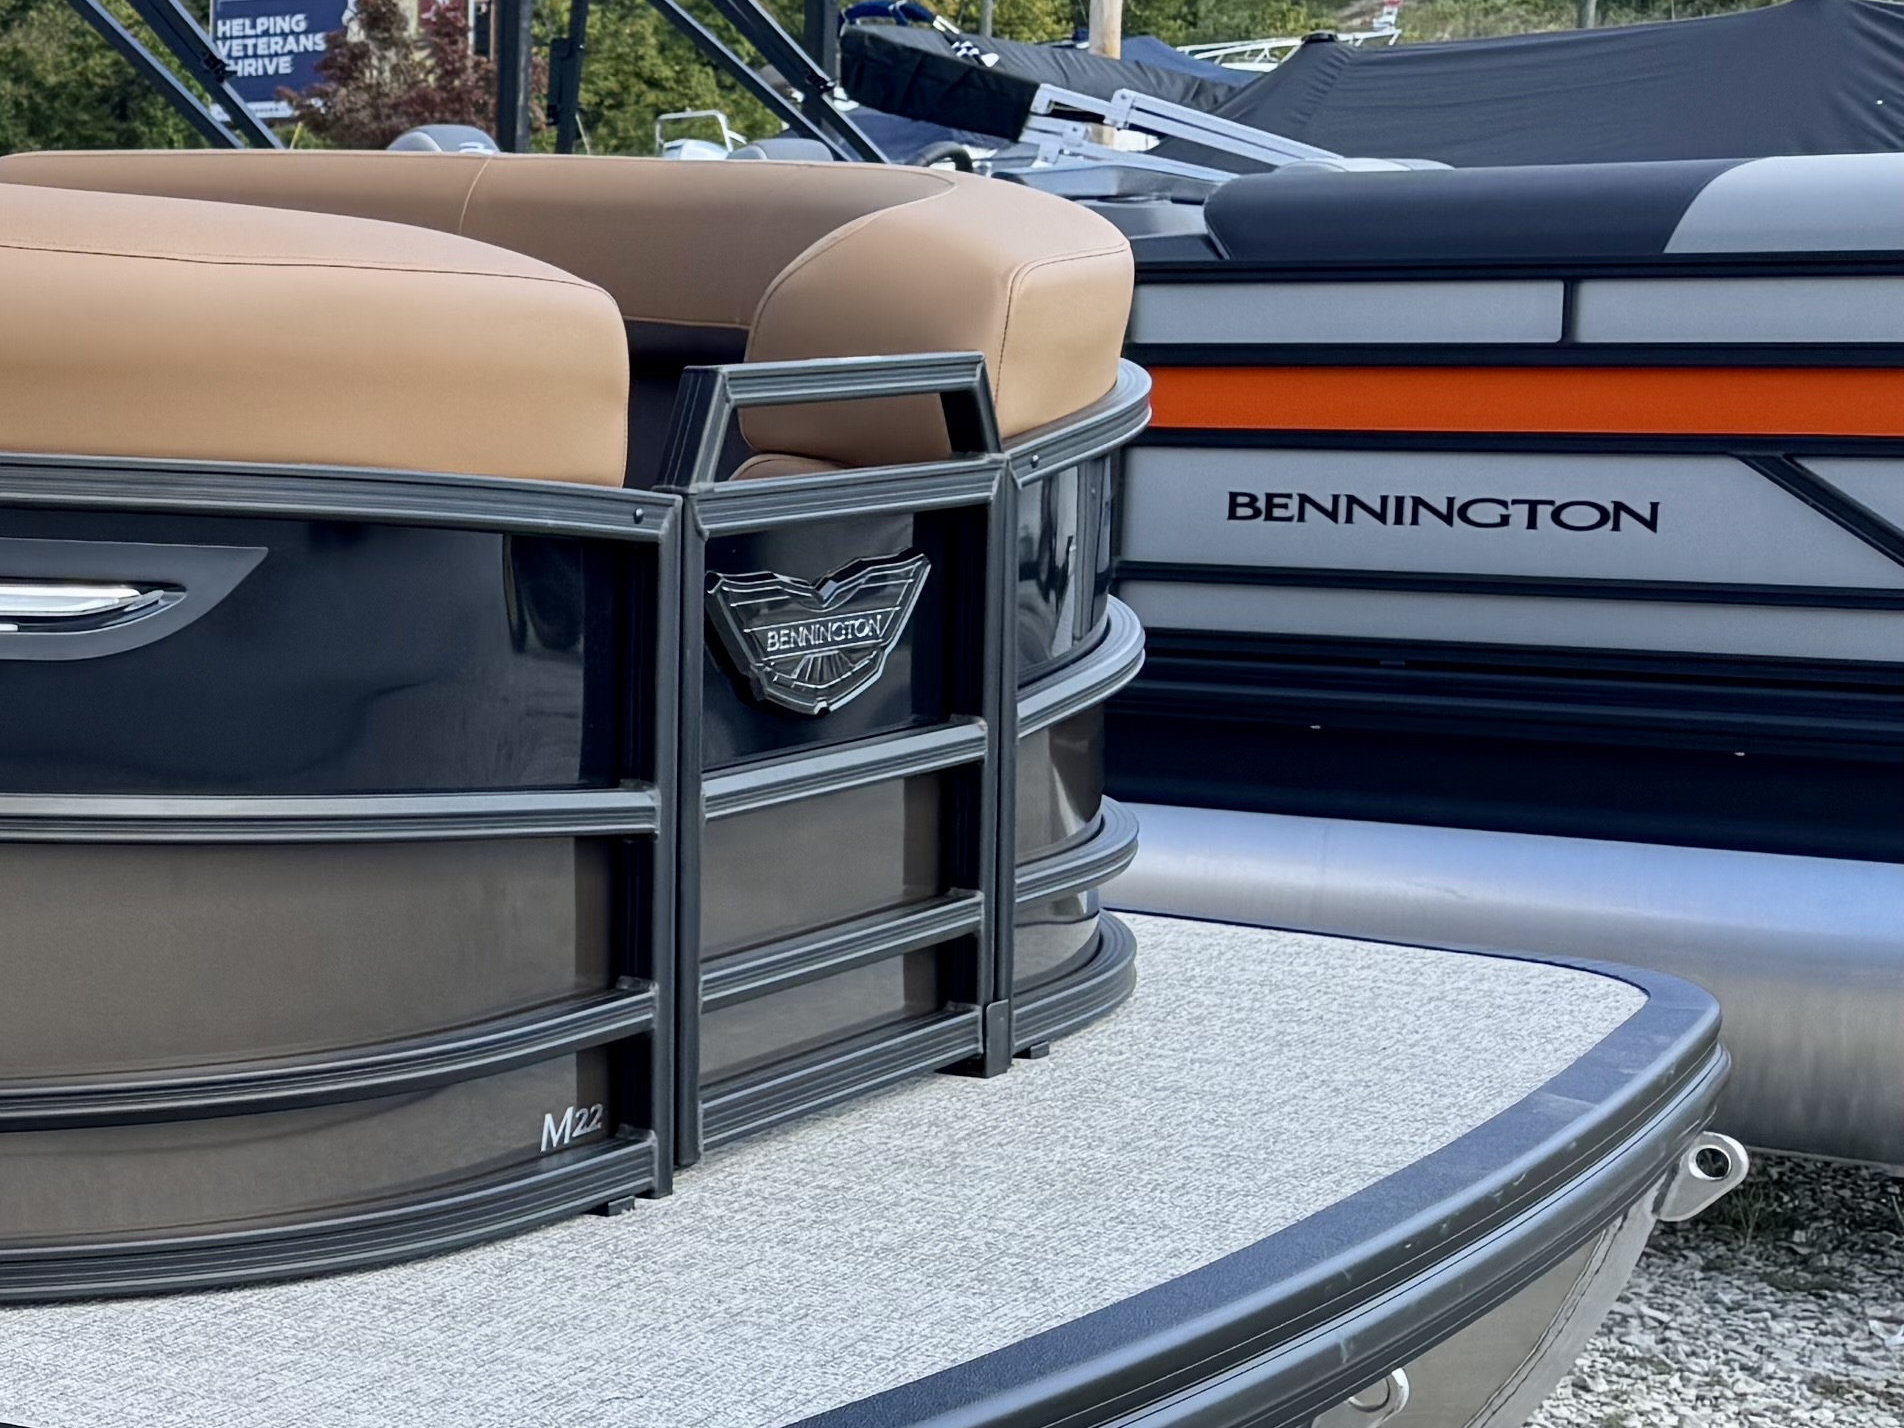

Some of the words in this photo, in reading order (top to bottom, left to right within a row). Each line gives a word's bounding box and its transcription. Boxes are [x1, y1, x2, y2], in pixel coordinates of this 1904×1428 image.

[217, 13, 306, 38] HELPING
[217, 32, 328, 58] VETERANS
[1227, 492, 1660, 533] BENNINGTON
[766, 615, 882, 651] BENNINGTON
[540, 1104, 603, 1152] M22
